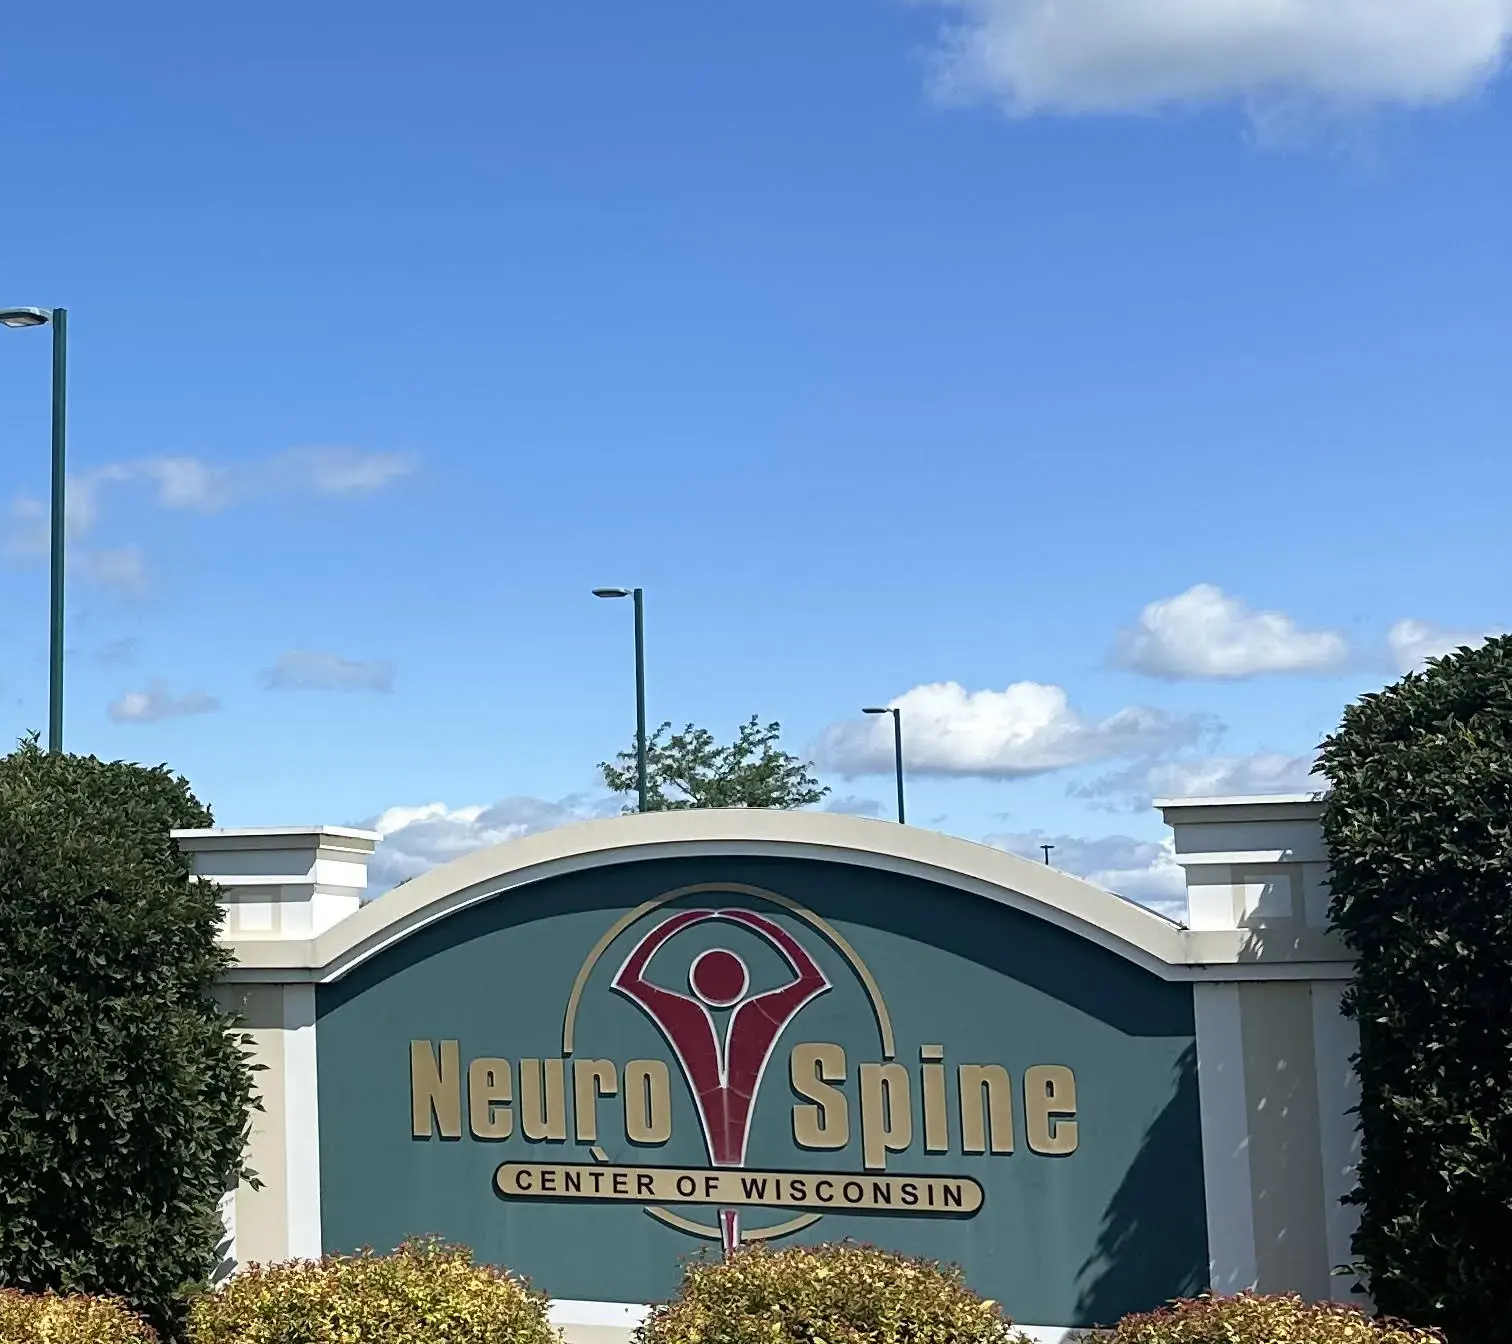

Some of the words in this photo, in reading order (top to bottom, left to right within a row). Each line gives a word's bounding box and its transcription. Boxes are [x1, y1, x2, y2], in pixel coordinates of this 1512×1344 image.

[409, 1039, 672, 1145] Neuro
[790, 1042, 1080, 1170] Spine
[515, 1169, 656, 1196] CENTER
[675, 1174, 720, 1199] OF
[740, 1177, 964, 1208] WISCONSIN
